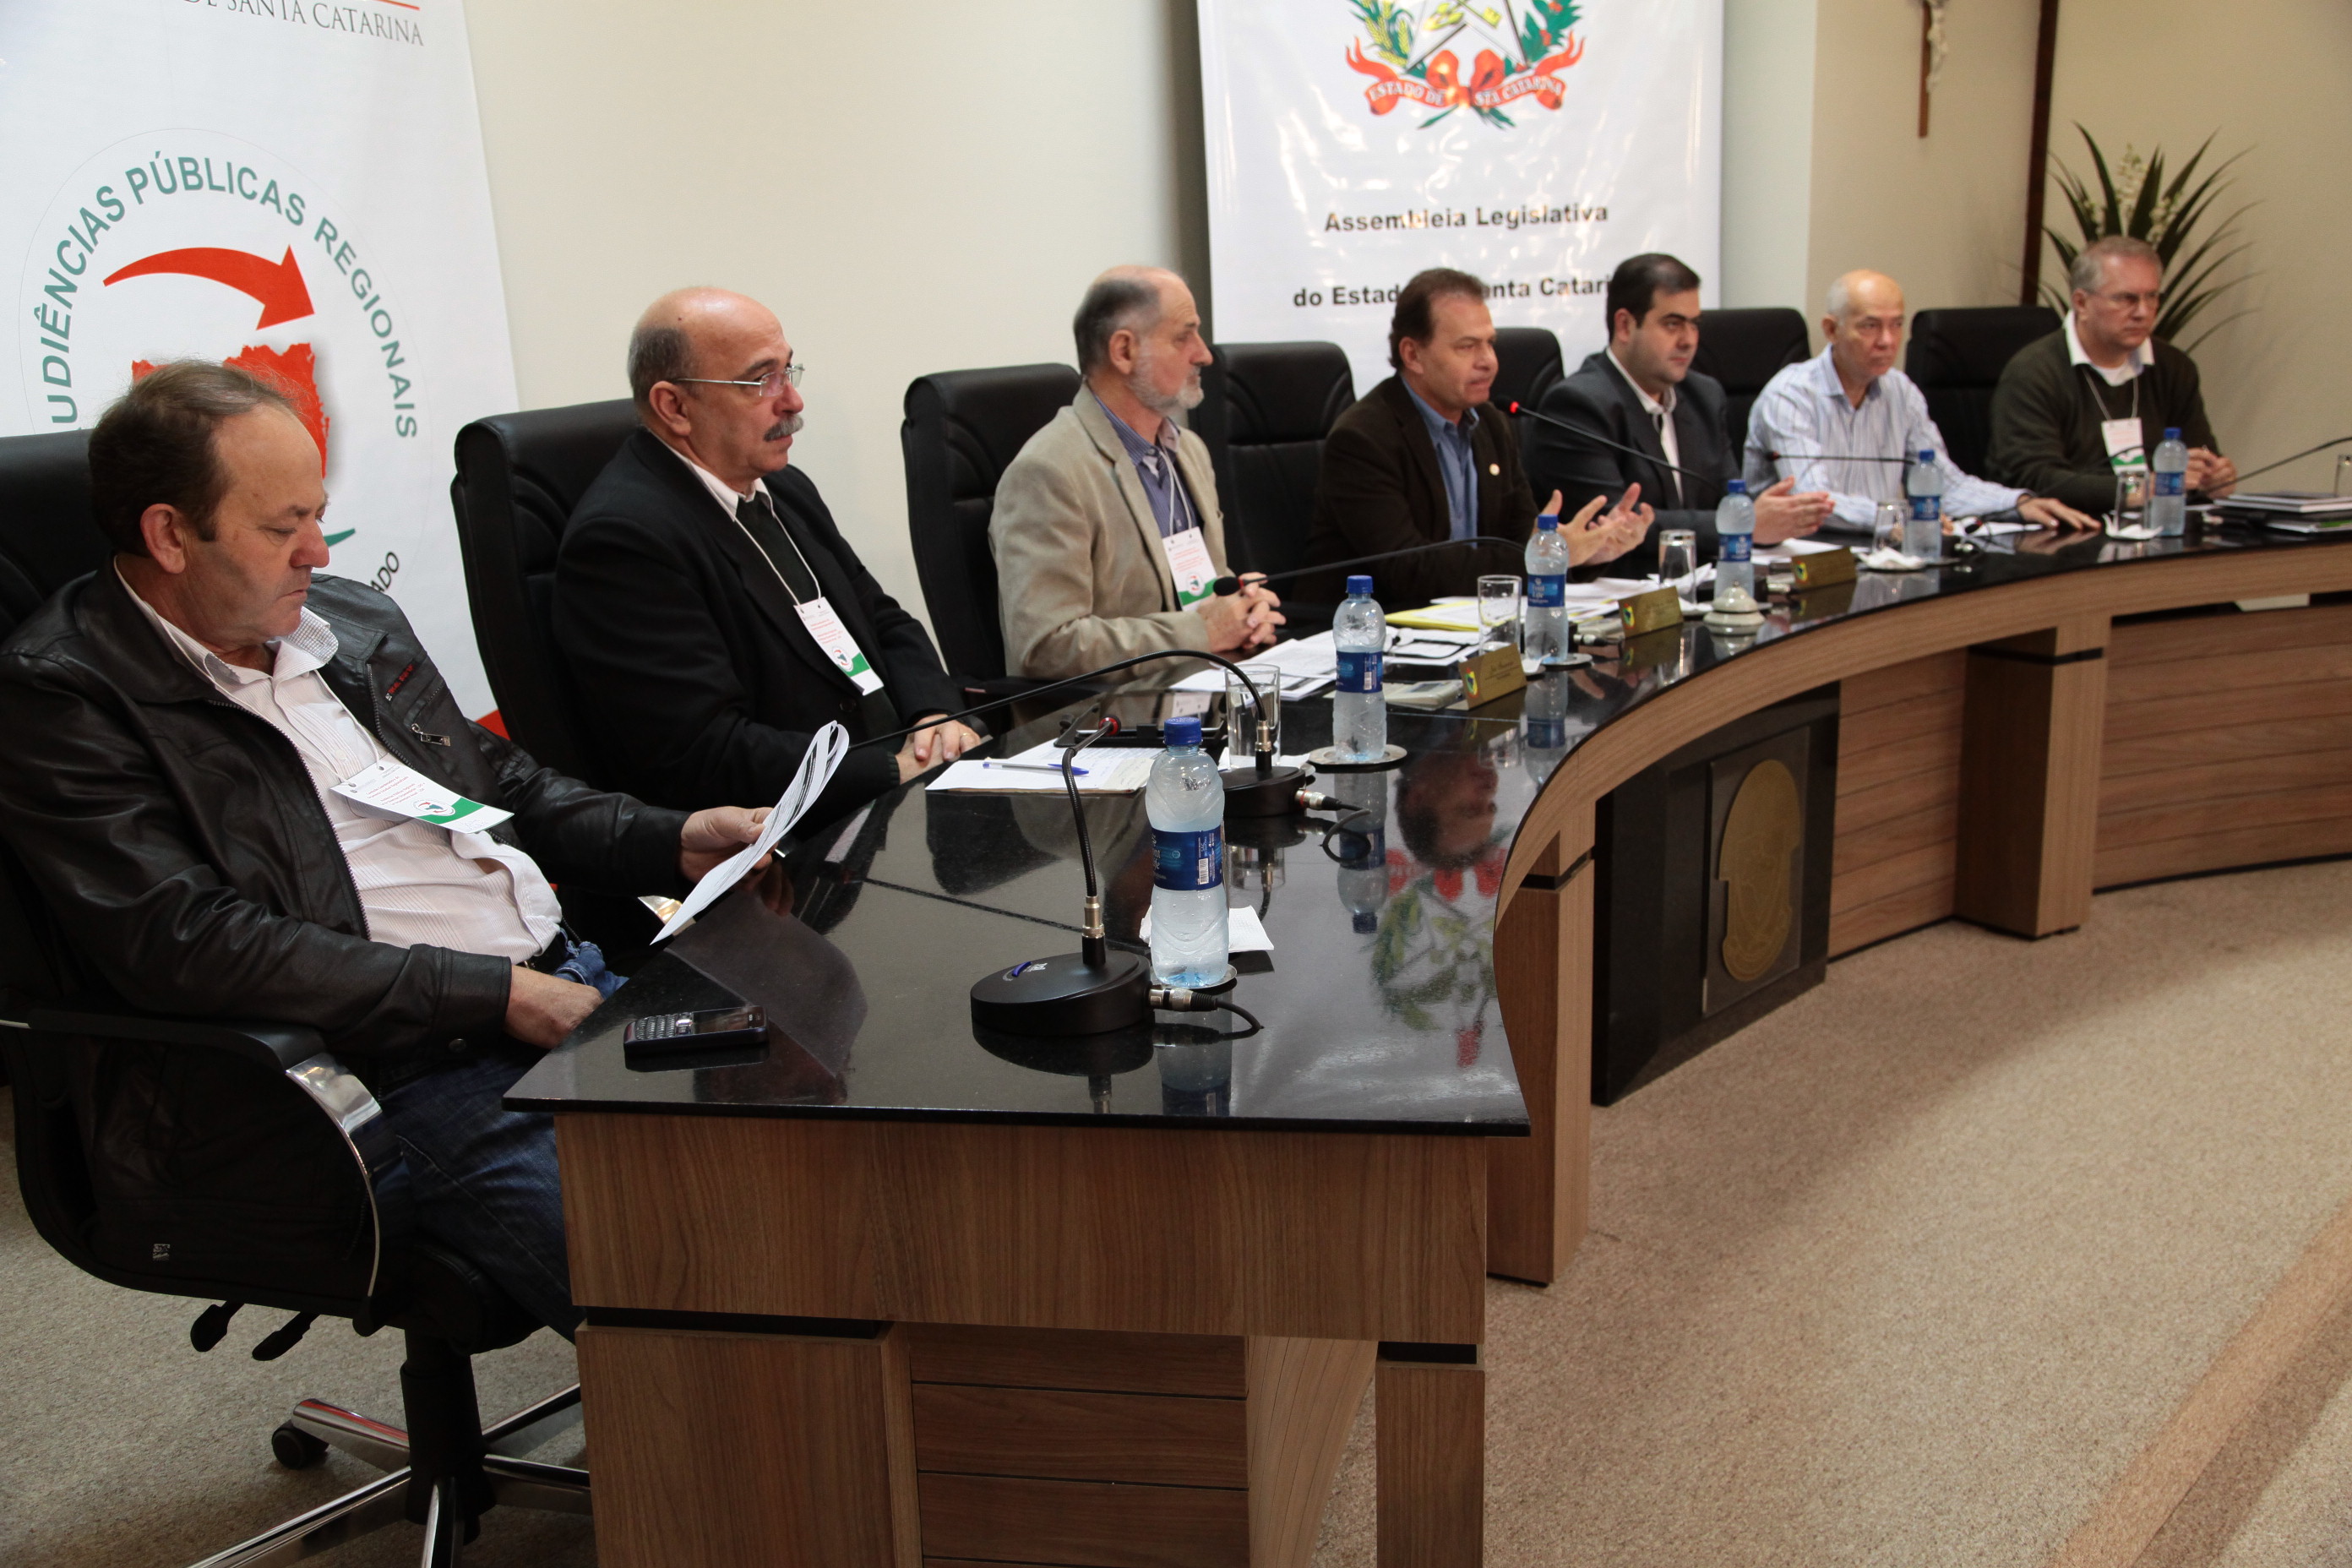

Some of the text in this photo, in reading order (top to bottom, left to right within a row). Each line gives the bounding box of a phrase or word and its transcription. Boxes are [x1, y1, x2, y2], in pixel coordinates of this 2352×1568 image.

[313, 3, 424, 46] CATARINA
[1369, 81, 1425, 102] ESTADO
[1325, 203, 1609, 231] Assembleia Legislativa
[34, 150, 417, 439] UDIÊNCIAS PÚBLICAS REGIONAIS
[1293, 288, 1322, 307] do
[1332, 284, 1400, 305] Estad
[371, 552, 400, 591] ADO
